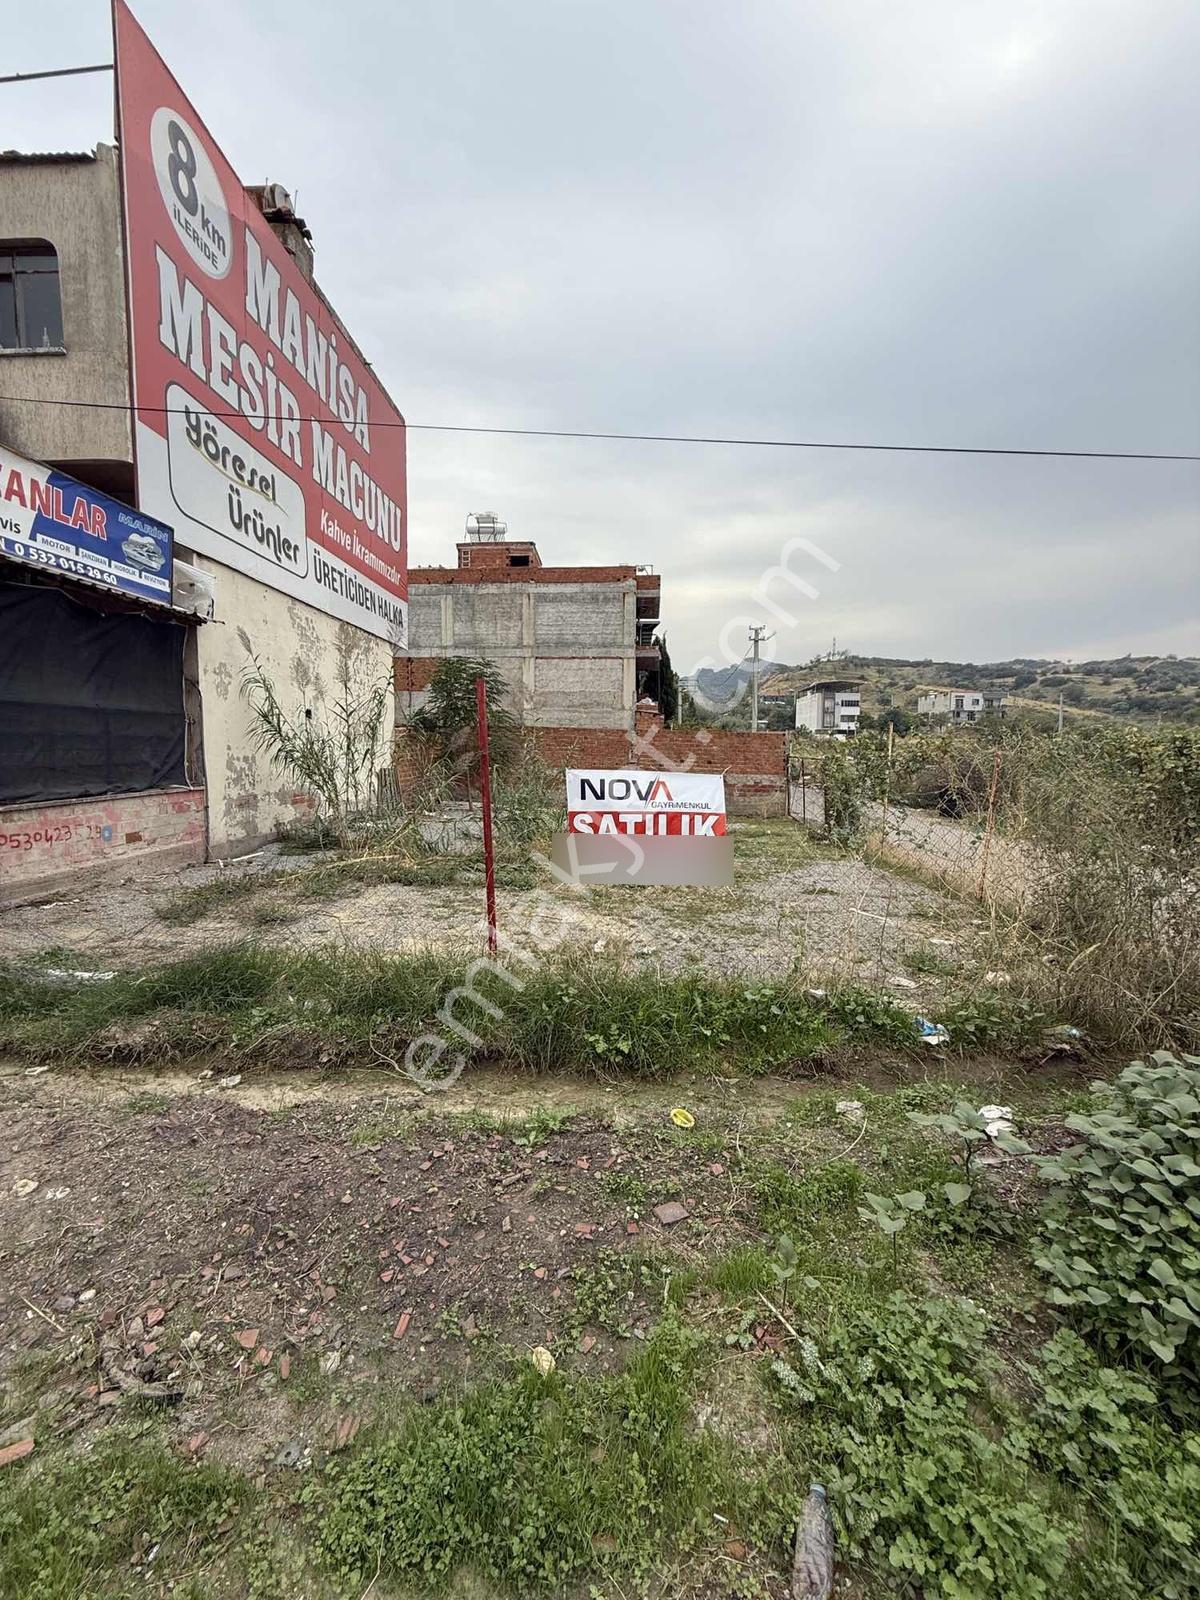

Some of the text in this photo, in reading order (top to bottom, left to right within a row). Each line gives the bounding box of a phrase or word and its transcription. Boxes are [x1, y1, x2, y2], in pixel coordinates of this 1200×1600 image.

[167, 119, 227, 258] 8 km
[245, 226, 371, 455] MANİSA
[155, 241, 402, 553] MESİR MACUNU
[184, 404, 277, 502] yöresel
[0, 462, 108, 542] ANLAR
[0, 516, 22, 535] vis
[228, 483, 300, 564] Ürünler
[320, 507, 351, 551] Kahve
[14, 542, 26, 556] 0
[28, 547, 57, 567] 532
[59, 557, 86, 575] 015
[86, 566, 102, 580] 29
[103, 572, 118, 586] 60
[41, 536, 71, 553] MOTOR
[313, 547, 405, 630] ÜRETİCİDEN HALKA
[579, 776, 674, 802] NOVA
